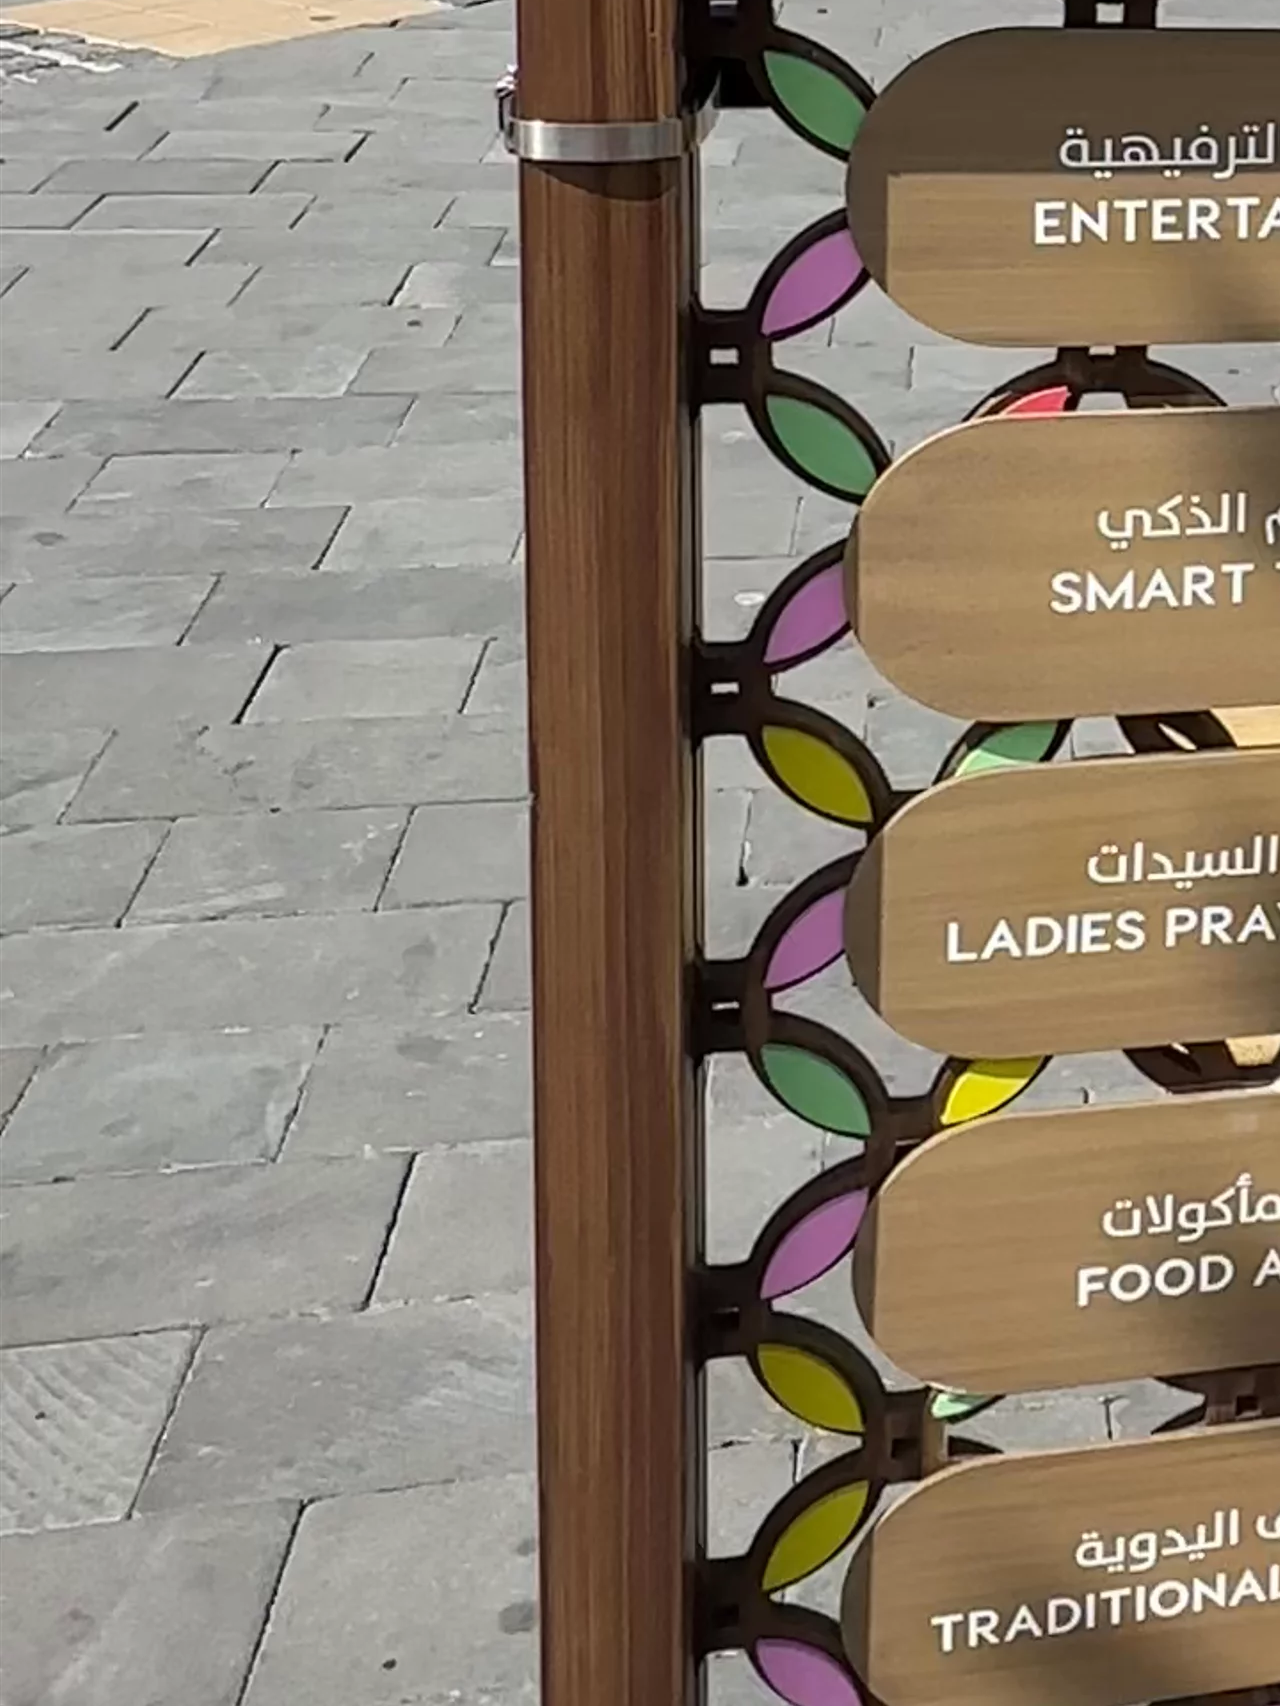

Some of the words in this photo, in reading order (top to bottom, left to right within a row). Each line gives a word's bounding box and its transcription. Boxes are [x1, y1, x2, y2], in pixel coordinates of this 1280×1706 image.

[1097, 492, 1246, 550] الذكي
[1051, 563, 1255, 613] SMART
[1087, 834, 1279, 889] السيدات
[947, 910, 1146, 962] LADIES
[1077, 1255, 1234, 1307] FOOD
[1075, 1508, 1239, 1573] اليدوية
